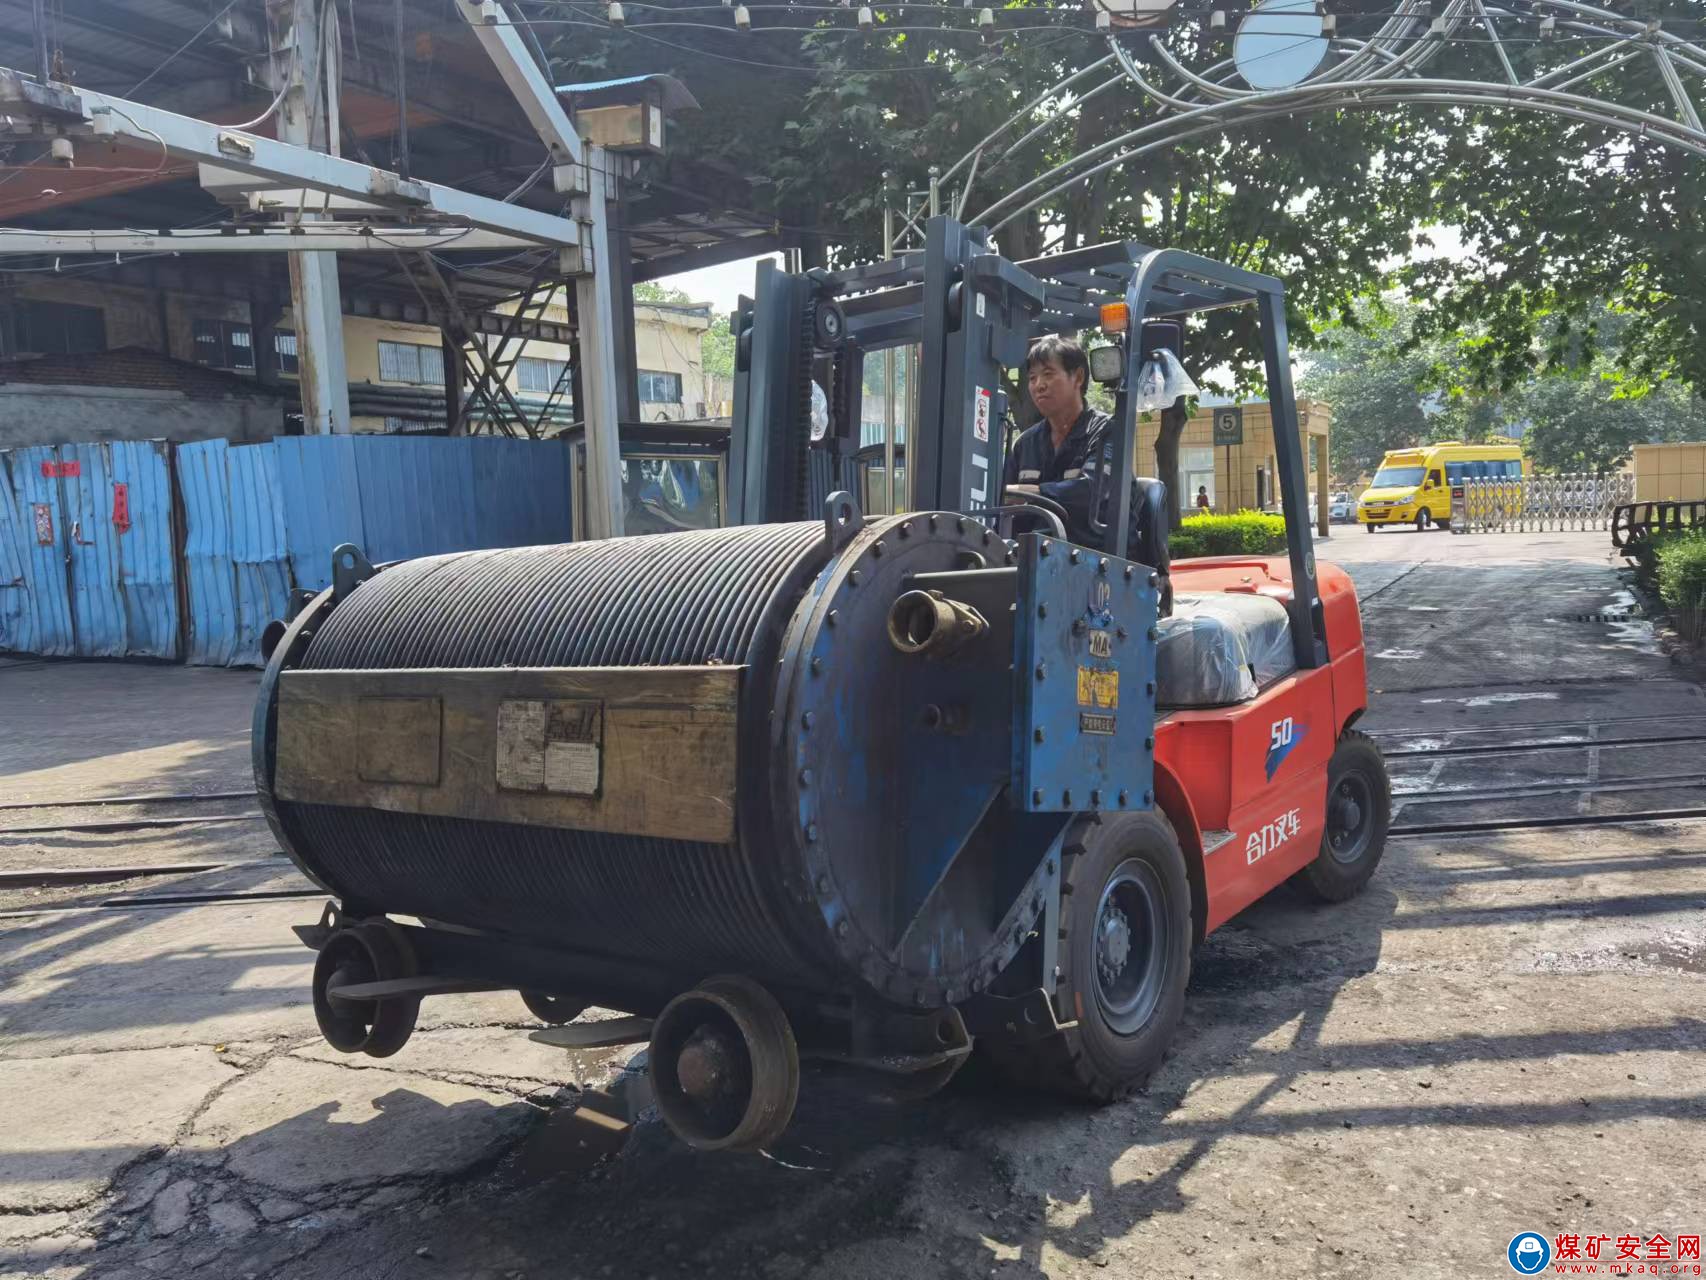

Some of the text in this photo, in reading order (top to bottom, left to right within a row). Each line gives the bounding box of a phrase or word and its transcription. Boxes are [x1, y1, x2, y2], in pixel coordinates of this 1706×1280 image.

[1223, 415, 1233, 430] 5
[1092, 633, 1108, 655] MA
[1270, 717, 1293, 751] 50
[1245, 808, 1301, 865] 合力叉车
